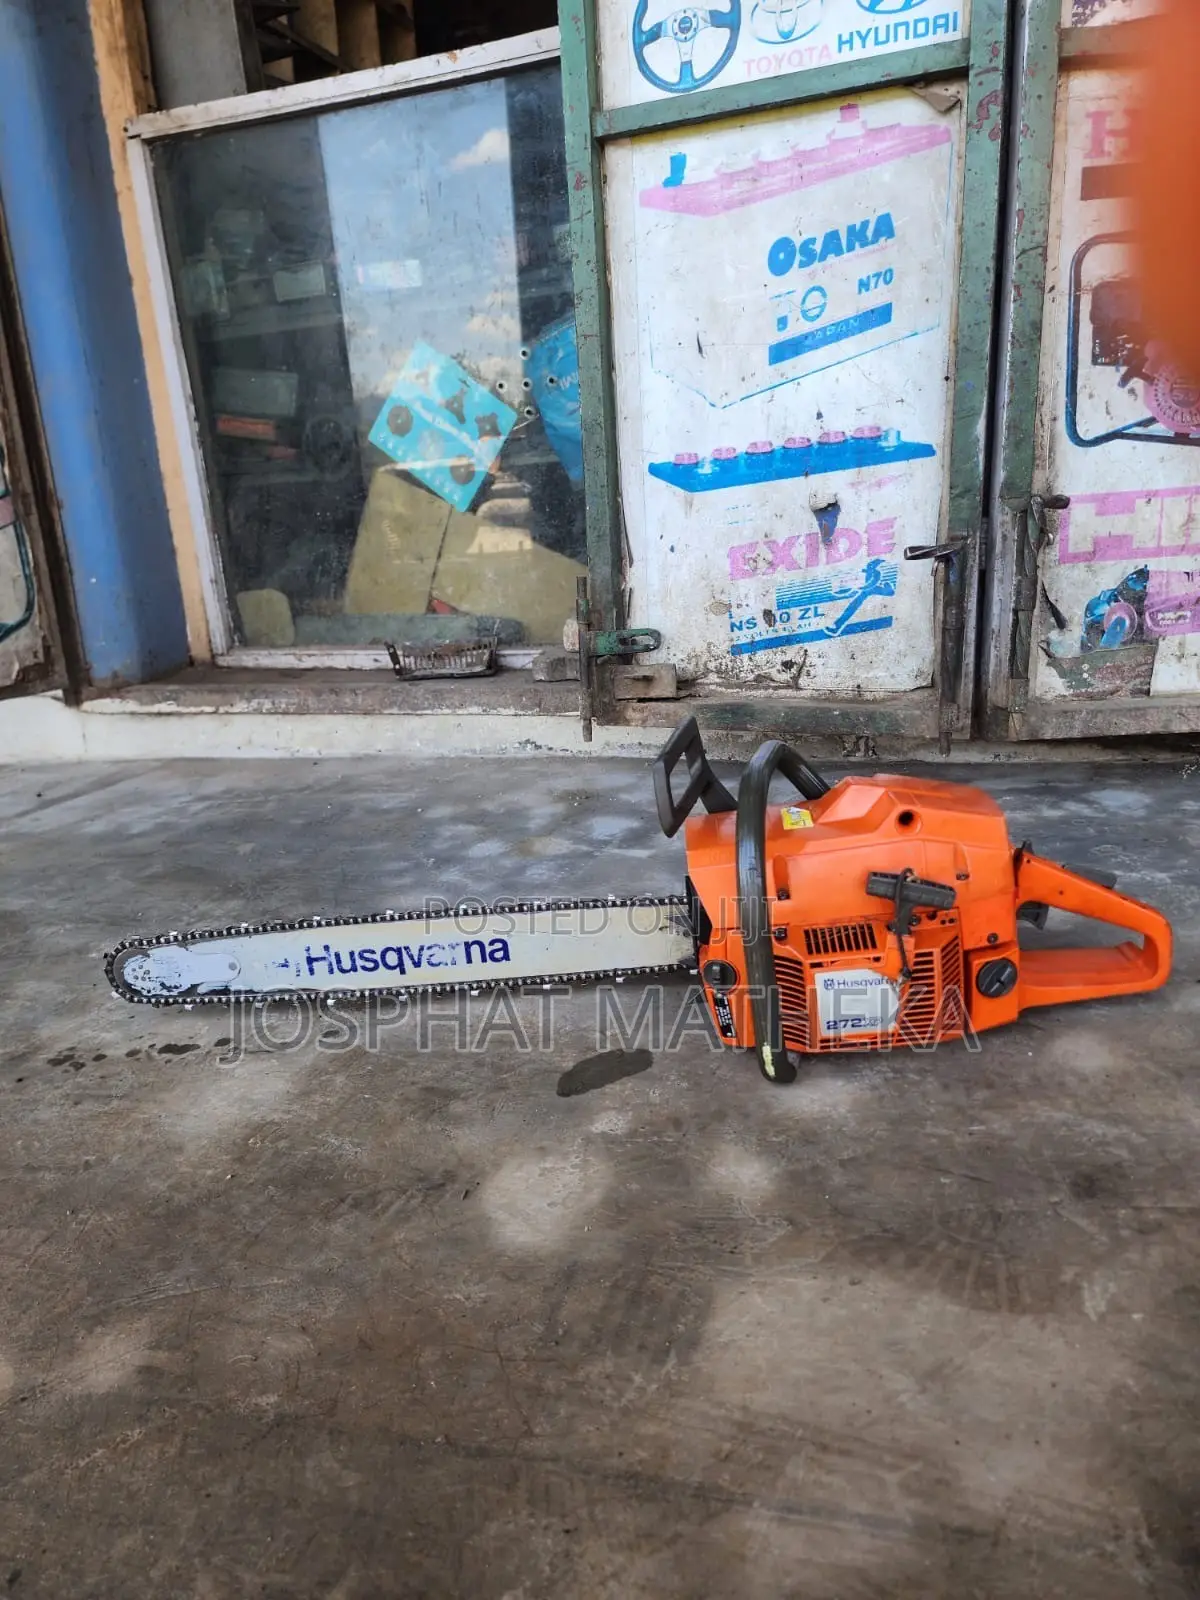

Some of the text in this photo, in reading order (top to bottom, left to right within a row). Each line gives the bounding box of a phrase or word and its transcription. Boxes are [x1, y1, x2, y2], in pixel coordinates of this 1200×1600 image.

[838, 11, 958, 53] HYUNDAI
[744, 44, 832, 77] TOYOTA
[768, 212, 895, 276] OSAKA
[857, 267, 894, 295] N70
[727, 517, 898, 581] EXIDE
[730, 616, 757, 632] NS
[798, 606, 825, 620] ZL
[304, 937, 511, 976] Husqvarna
